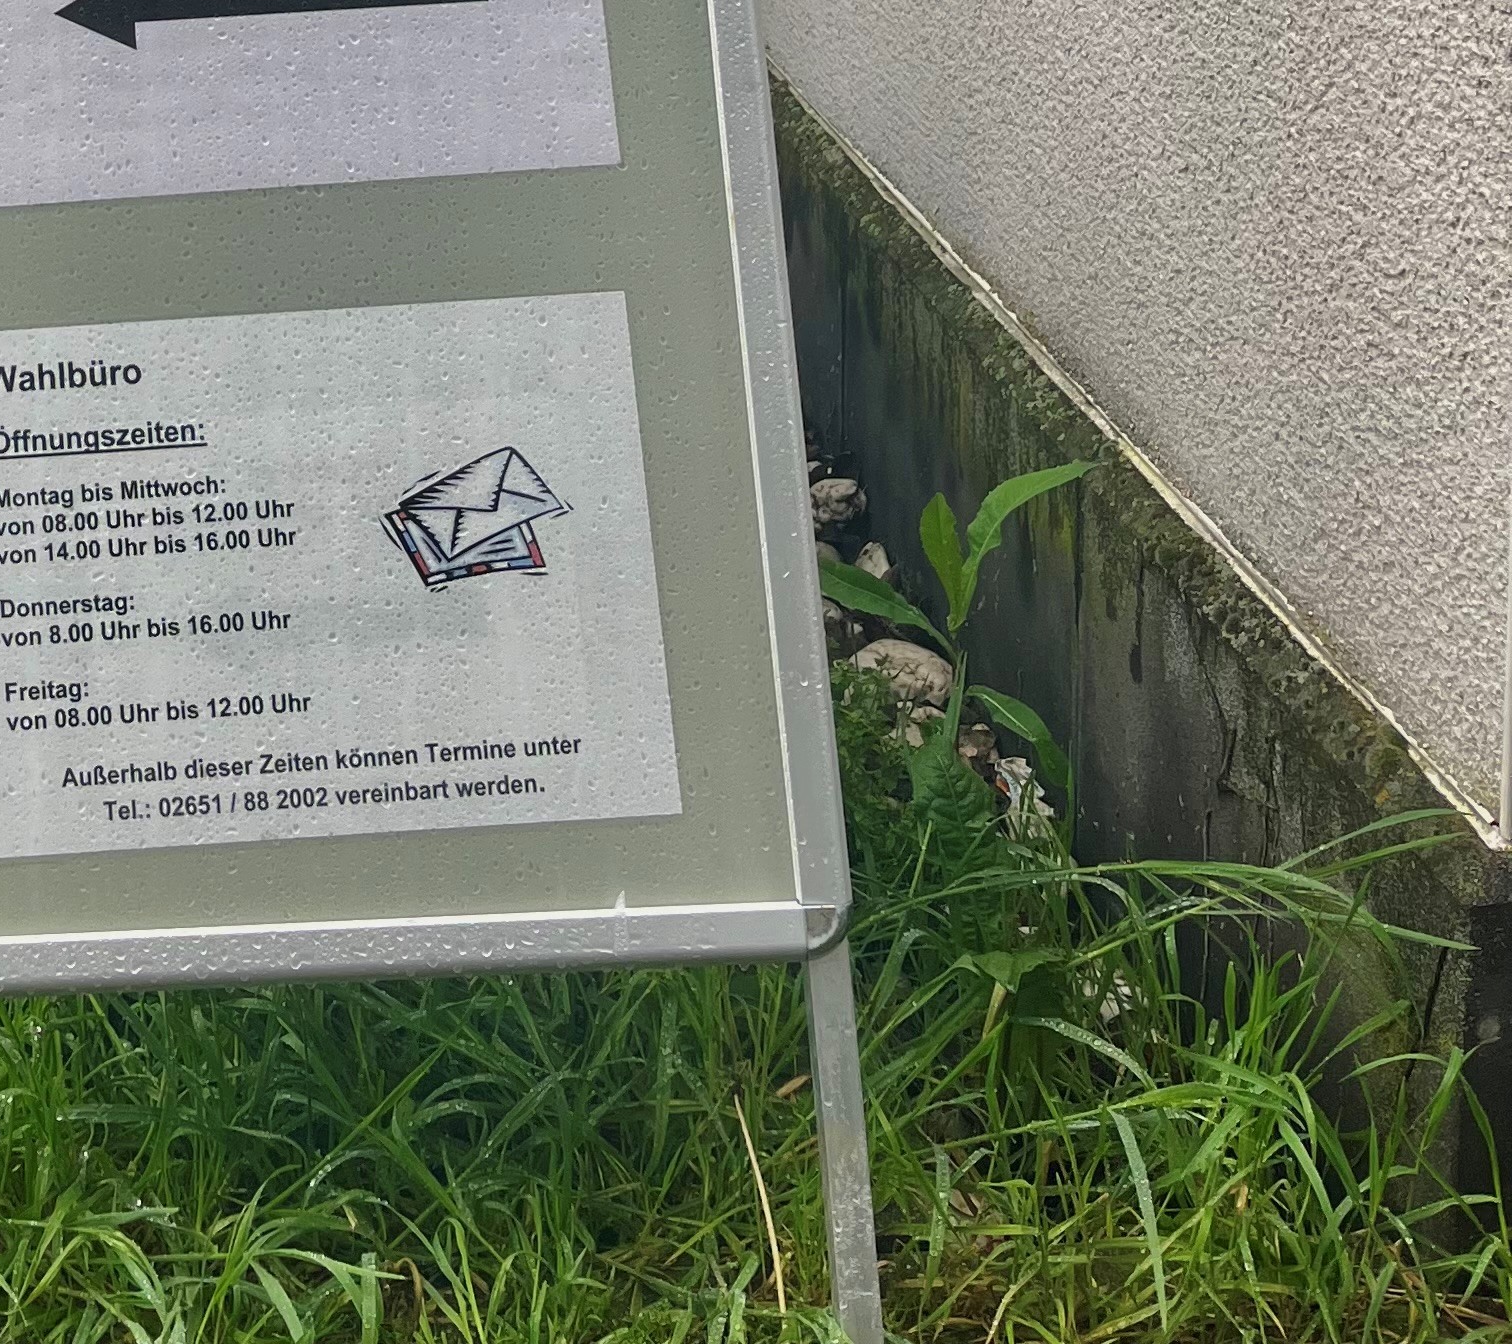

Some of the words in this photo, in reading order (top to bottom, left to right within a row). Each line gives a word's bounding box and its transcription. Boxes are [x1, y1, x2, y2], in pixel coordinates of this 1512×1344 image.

[81, 483, 113, 502] bis
[120, 475, 226, 500] Mittwoch:
[42, 511, 98, 533] 08.00
[106, 510, 145, 529] Uhr
[152, 507, 184, 526] bis
[192, 501, 248, 523] 12.00
[255, 498, 295, 519] Uhr
[44, 540, 100, 562] 14.00
[108, 538, 147, 558] Uhr
[154, 535, 187, 554] bis
[194, 529, 250, 551] 16.00
[258, 527, 296, 547] Uhr
[0, 594, 134, 618] Donnerstag:
[1, 629, 42, 647] von
[49, 624, 93, 644] 8.00
[101, 621, 141, 641] Uhr
[147, 617, 180, 637] bis
[188, 612, 244, 635] 16.00
[251, 610, 291, 630] Uhr
[4, 680, 89, 702] Freitag:
[6, 712, 47, 731] von
[54, 705, 112, 728] 08.00
[119, 704, 159, 724] Uhr
[166, 700, 199, 720] bis
[206, 696, 264, 718] 12.00
[271, 693, 311, 713] Uhr
[62, 761, 178, 788] Außerhalb
[184, 758, 253, 779] dieser
[259, 752, 328, 774] Zeiten
[336, 746, 419, 770] können
[424, 740, 516, 763] Termine
[523, 736, 581, 757] unter
[104, 800, 151, 821] Tel.:
[159, 793, 221, 818] 02651
[231, 792, 236, 813] /
[244, 790, 269, 812] 88
[275, 786, 328, 810] 2002
[335, 780, 449, 805] vereinbart
[455, 775, 545, 798] werden.
